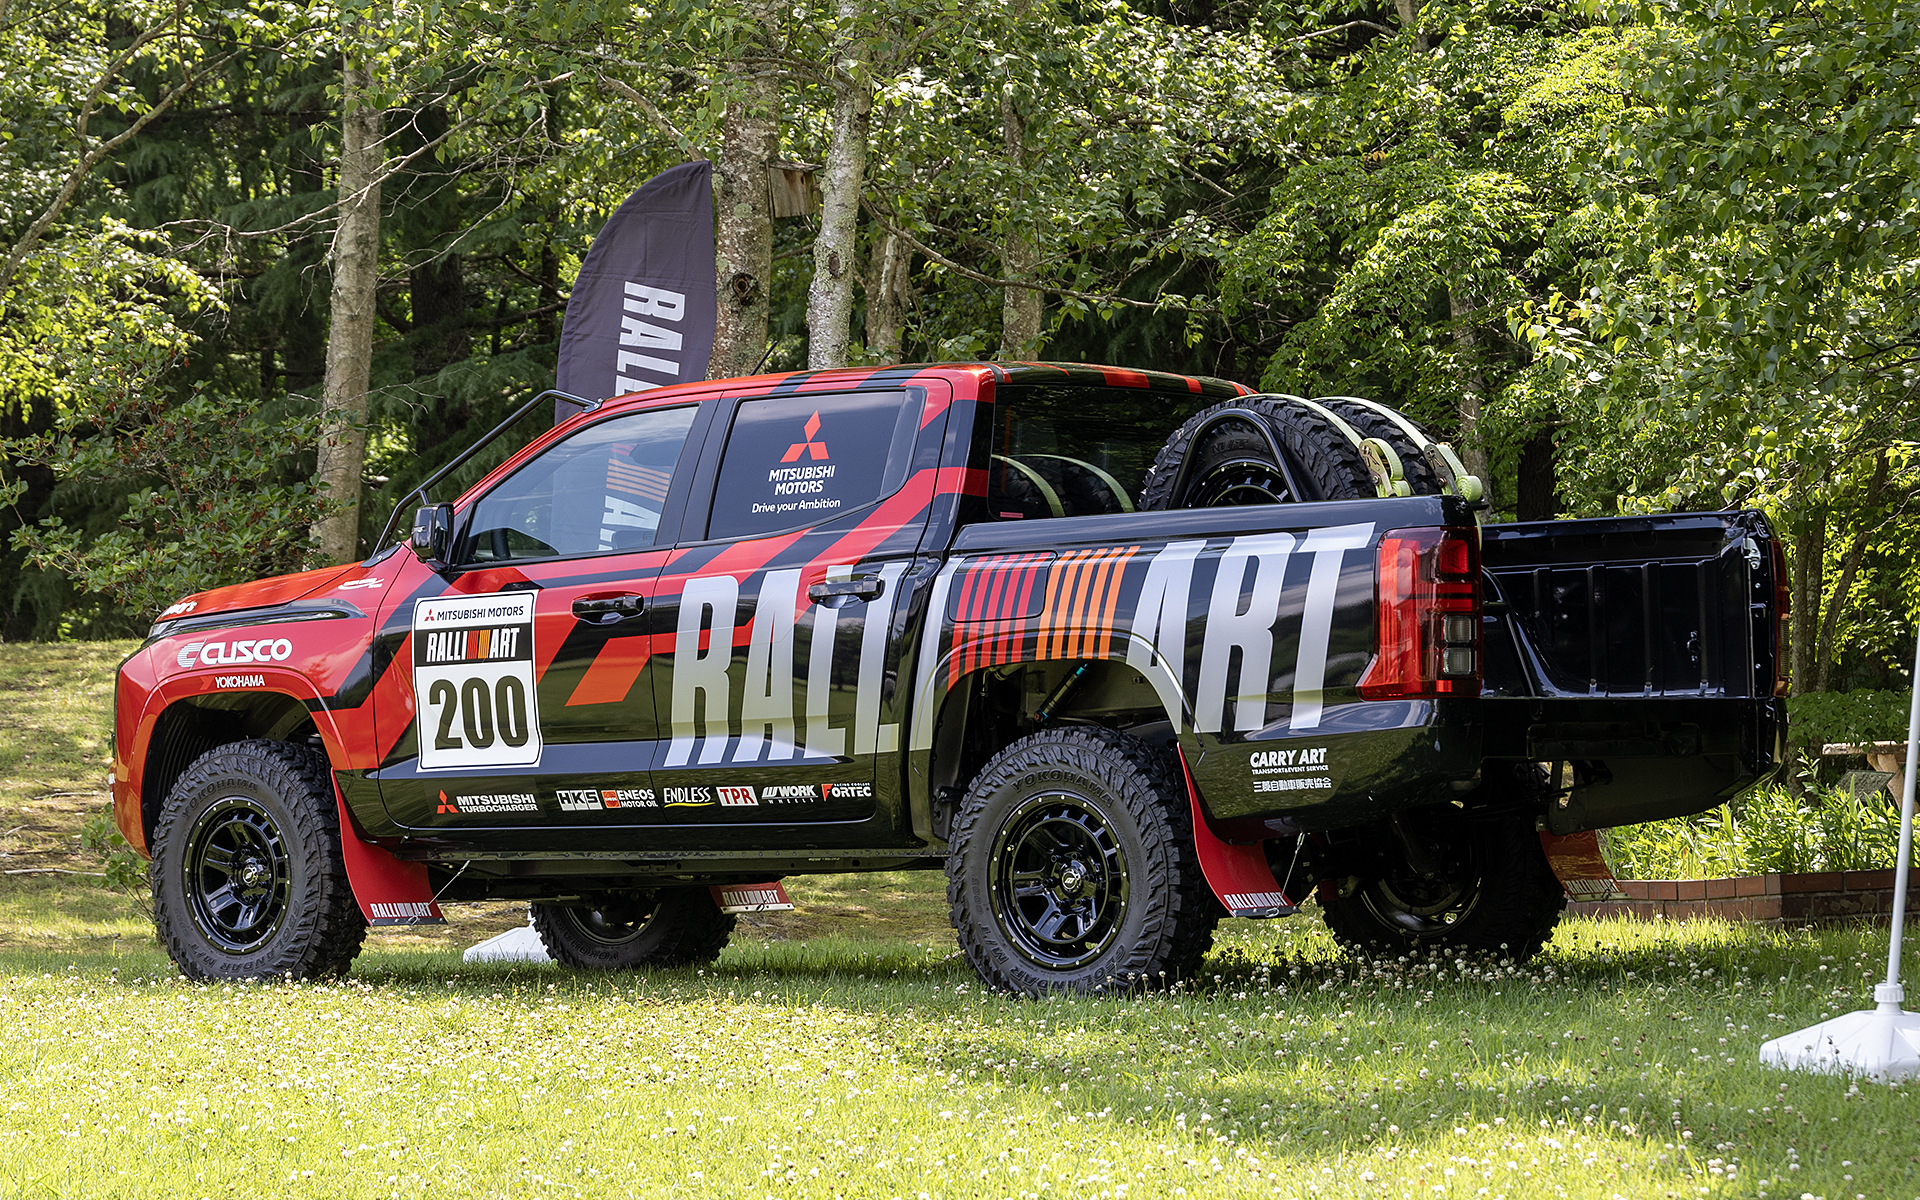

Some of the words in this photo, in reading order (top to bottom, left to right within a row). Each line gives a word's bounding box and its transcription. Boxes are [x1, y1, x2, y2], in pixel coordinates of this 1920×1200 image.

[768, 465, 836, 482] MITSUBISHI
[774, 480, 825, 496] MOTORS
[751, 502, 776, 513] Drive
[776, 502, 798, 515] your
[798, 498, 841, 510] Ambition
[437, 608, 486, 621] MITSUBISHI
[487, 606, 524, 618] MOTORS
[199, 638, 294, 666] CUSCO
[214, 675, 265, 689] YOKOHAMA
[429, 675, 530, 750] 200
[1250, 749, 1298, 768] CARRY
[1298, 747, 1327, 765] ART
[1306, 764, 1329, 772] SERVICE
[616, 789, 656, 801] ENEOS
[663, 787, 710, 803] ENDLESS
[779, 784, 817, 797] WORK
[821, 784, 873, 801] FORTEC
[1011, 768, 1115, 808] YOKOHAMA
[182, 776, 259, 819] YOKOHAMA
[456, 793, 536, 806] MITSUBISHI
[557, 790, 602, 809] HKS
[620, 800, 646, 808] MOTOR
[646, 800, 659, 808] OIL
[719, 788, 756, 805] TPR
[459, 803, 539, 814] TURBOCHARGER
